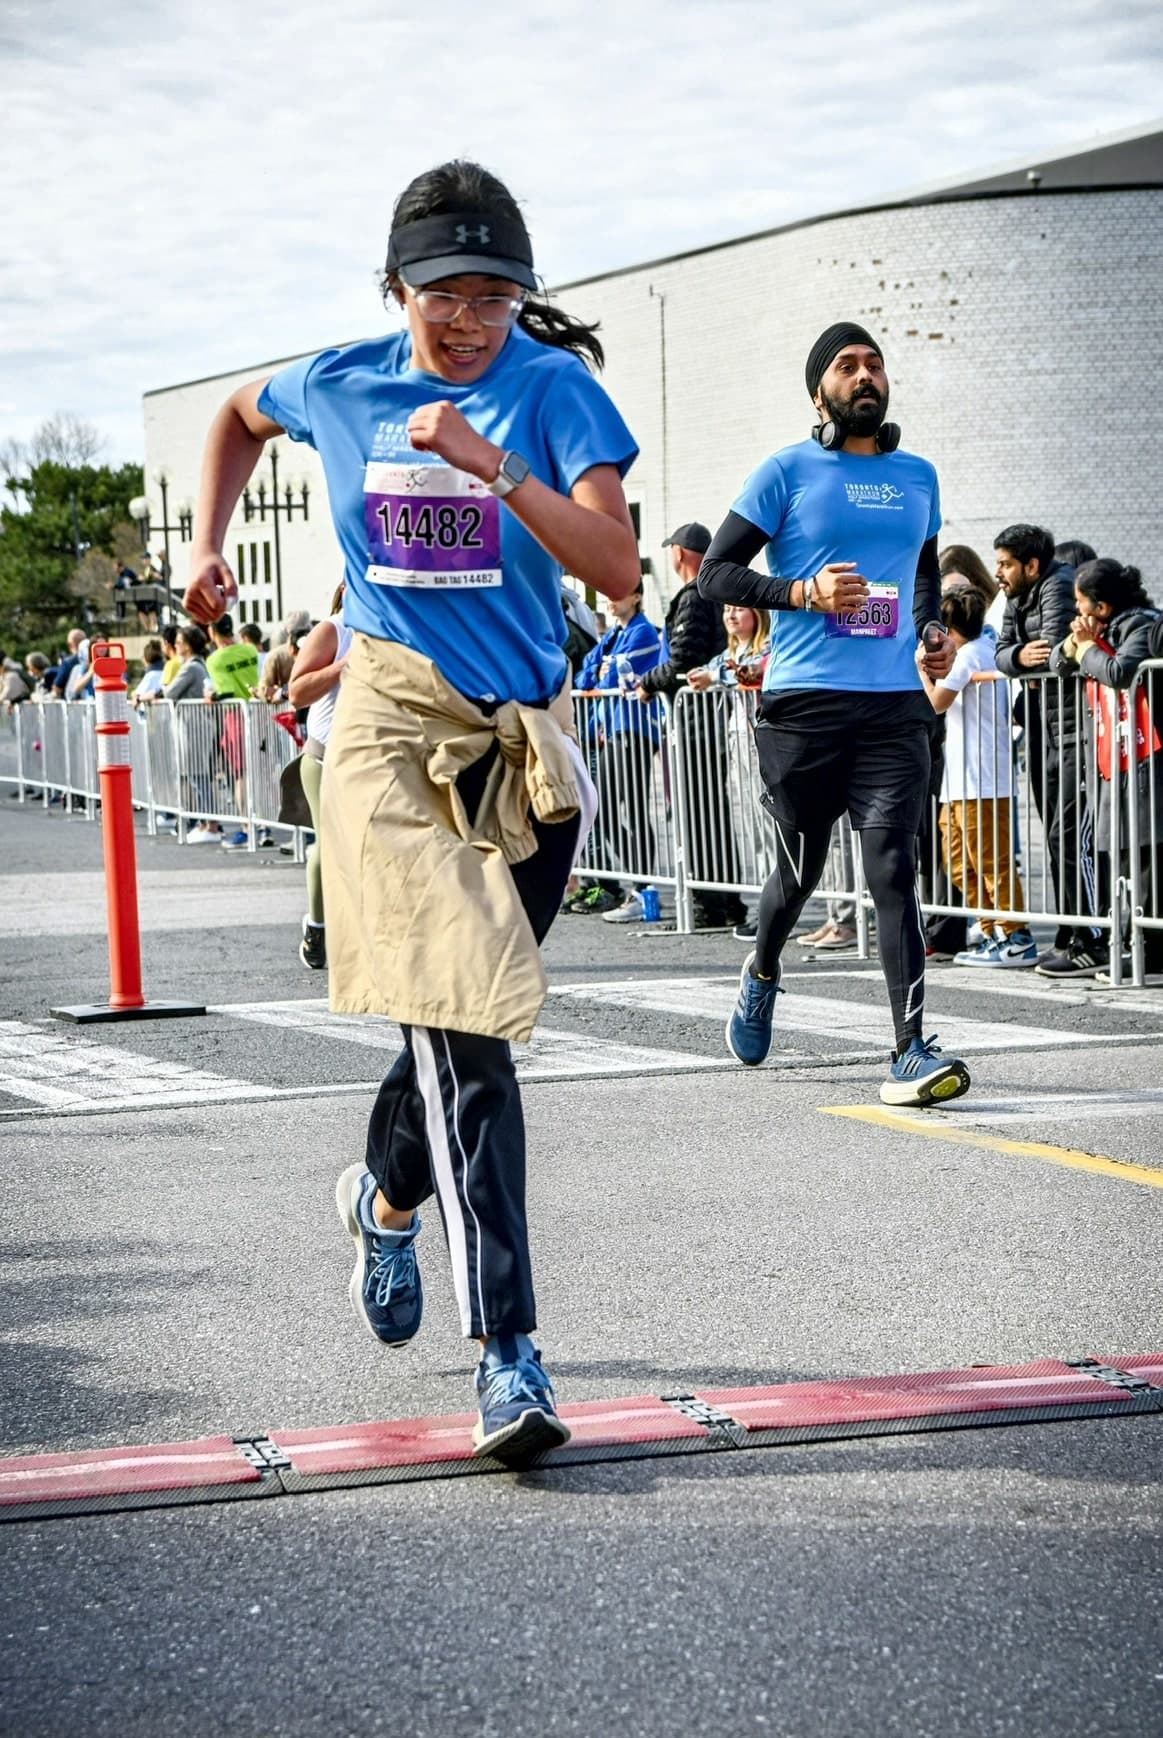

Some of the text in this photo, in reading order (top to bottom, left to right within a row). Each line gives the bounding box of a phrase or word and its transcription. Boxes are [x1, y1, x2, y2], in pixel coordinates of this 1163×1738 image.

[378, 422, 409, 433] TOR
[376, 501, 484, 548] 14482
[463, 573, 494, 584] 14482
[837, 601, 892, 626] 12563
